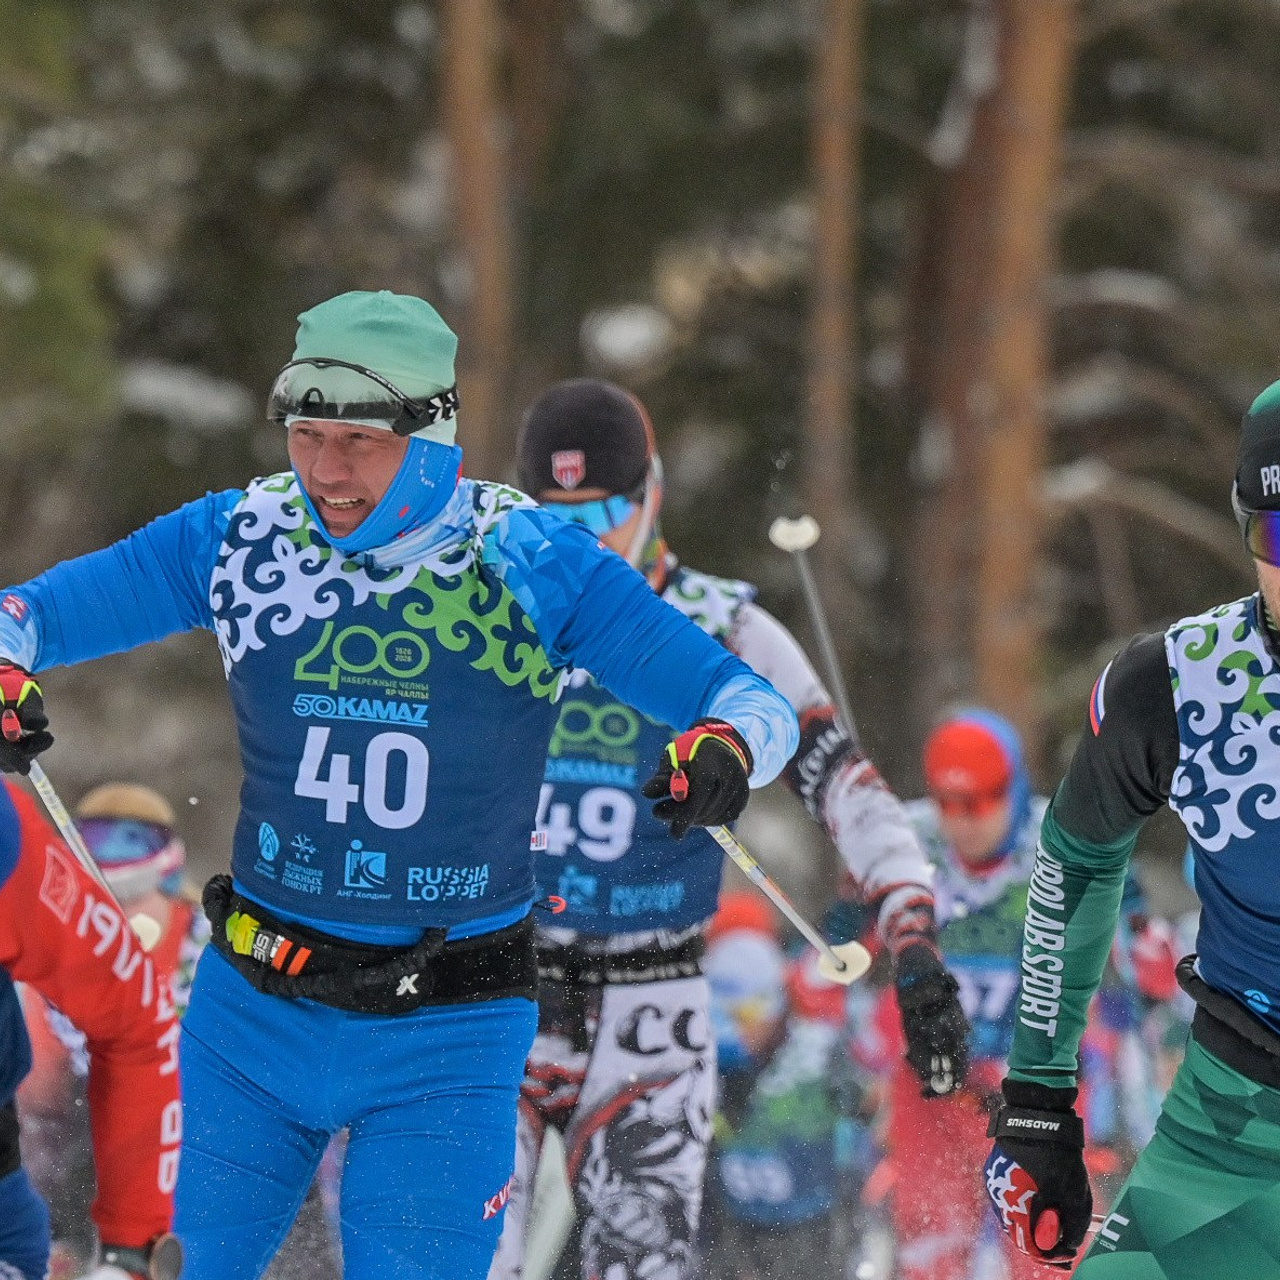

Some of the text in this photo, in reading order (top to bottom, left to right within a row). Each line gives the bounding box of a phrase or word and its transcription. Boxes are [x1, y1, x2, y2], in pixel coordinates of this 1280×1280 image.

[294, 620, 430, 691] 400
[340, 675, 398, 690] НАБЕРЕЖНЫЕ
[294, 725, 430, 830] 40
[535, 783, 637, 862] 49
[1005, 1117, 1061, 1131] MADSHUS
